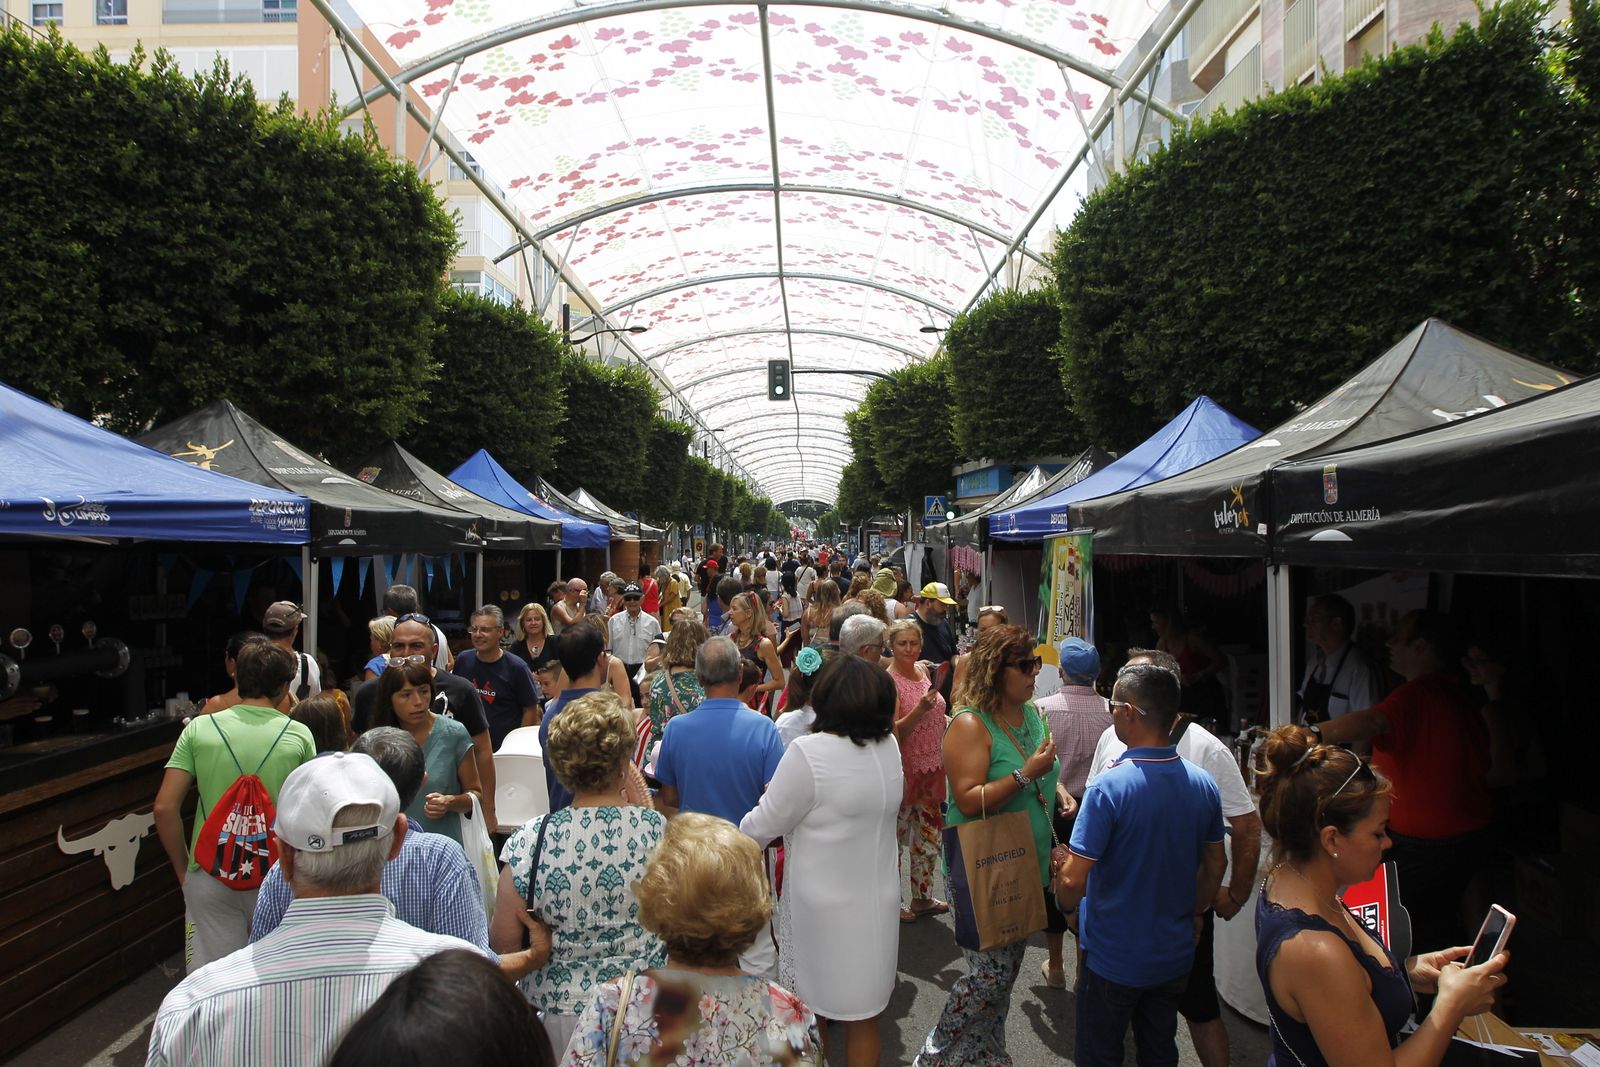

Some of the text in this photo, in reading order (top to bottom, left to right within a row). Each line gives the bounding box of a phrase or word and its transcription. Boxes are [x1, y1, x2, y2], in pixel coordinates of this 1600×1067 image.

[249, 497, 295, 515] DEPORTE
[1290, 506, 1381, 524] DIPUTACIÓN DE ALMERÍA
[975, 847, 1026, 870] SPRINGFIELD
[1364, 906, 1376, 929] OT
